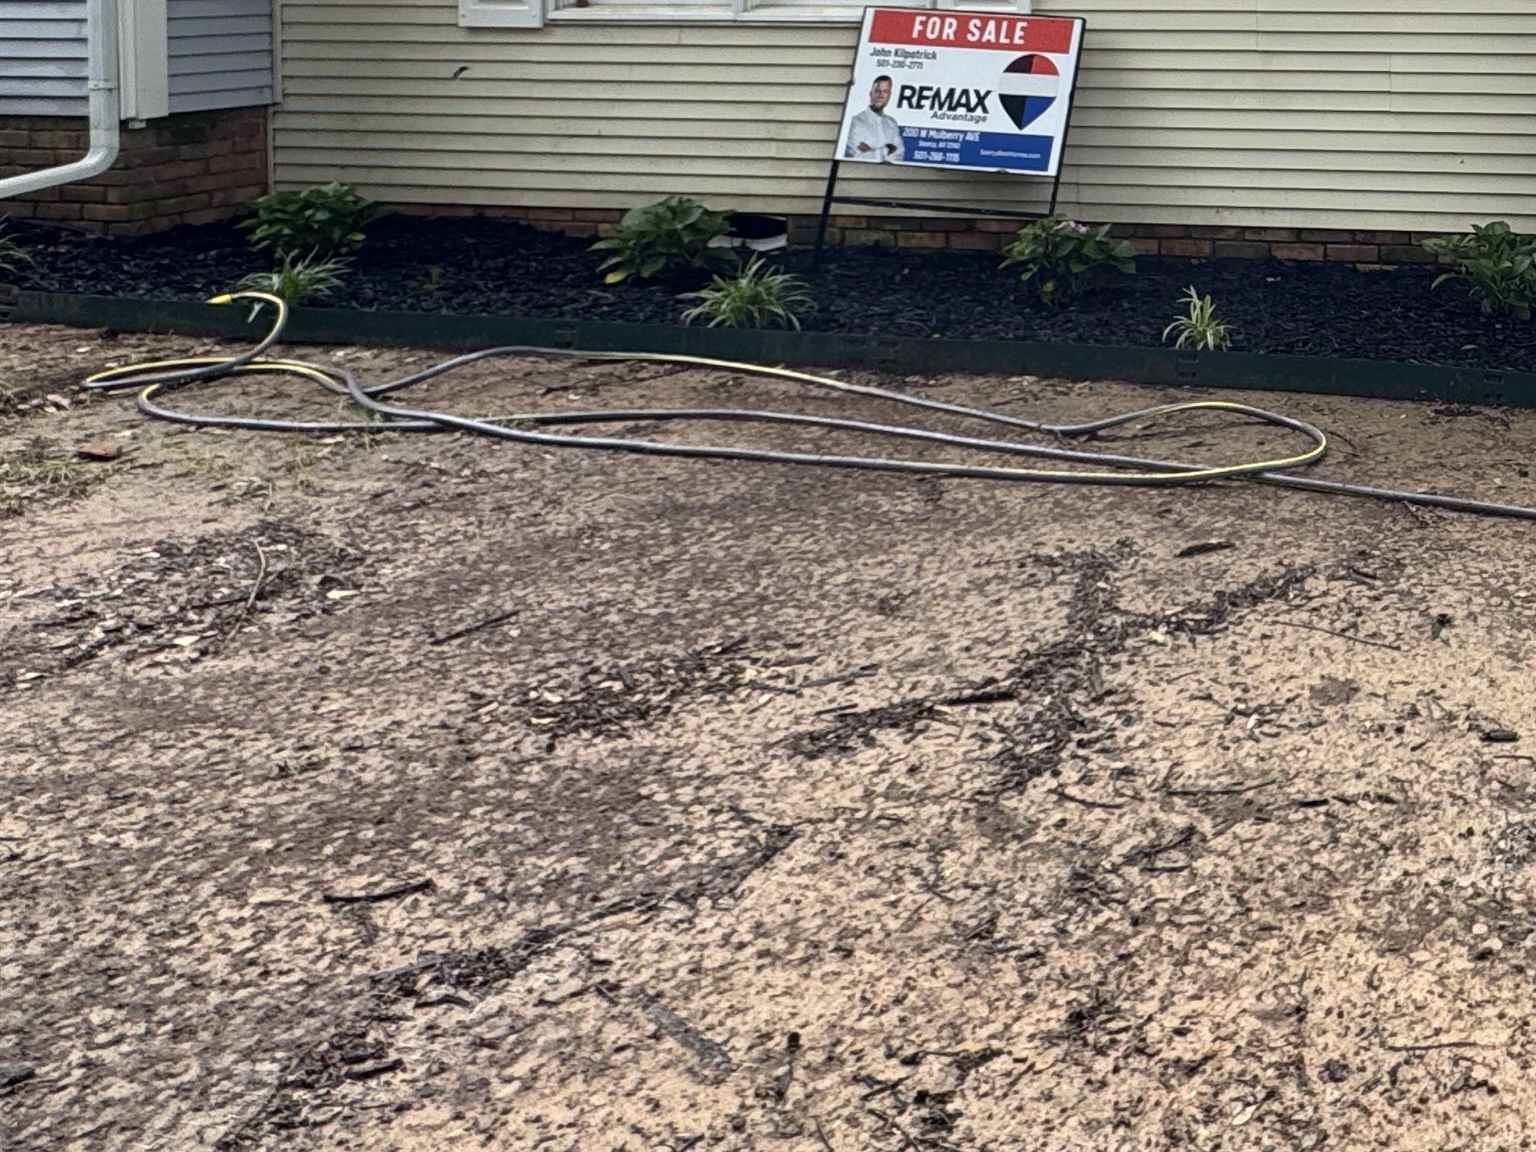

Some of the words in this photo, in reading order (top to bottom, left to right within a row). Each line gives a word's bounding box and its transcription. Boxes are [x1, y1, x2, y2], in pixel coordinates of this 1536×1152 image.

[912, 15, 958, 41] FOR
[966, 19, 1028, 45] SALE
[869, 47, 892, 57] John
[894, 48, 937, 60] Kilpatrick
[930, 111, 988, 124] Advantage
